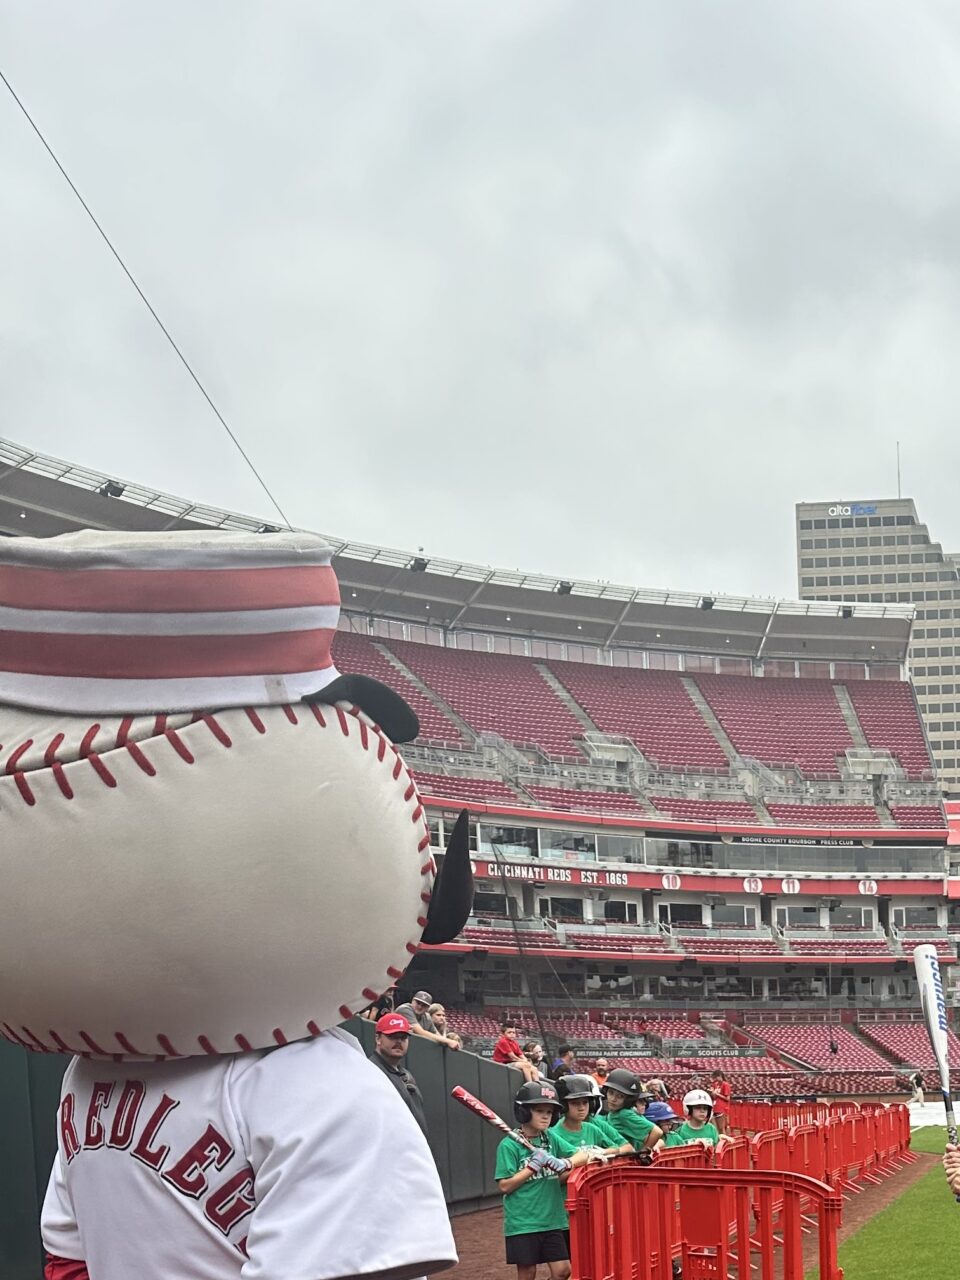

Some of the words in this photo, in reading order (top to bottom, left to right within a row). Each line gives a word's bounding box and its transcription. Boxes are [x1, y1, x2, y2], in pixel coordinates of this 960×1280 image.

[547, 868, 572, 882] REDS
[580, 871, 603, 884] EST.
[605, 872, 628, 885] 1869
[664, 875, 678, 890] 10
[746, 878, 759, 893] 13
[785, 879, 796, 893] 11
[862, 880, 874, 894] 14
[925, 954, 949, 1034] marucci
[60, 1079, 258, 1260] REDLEG
